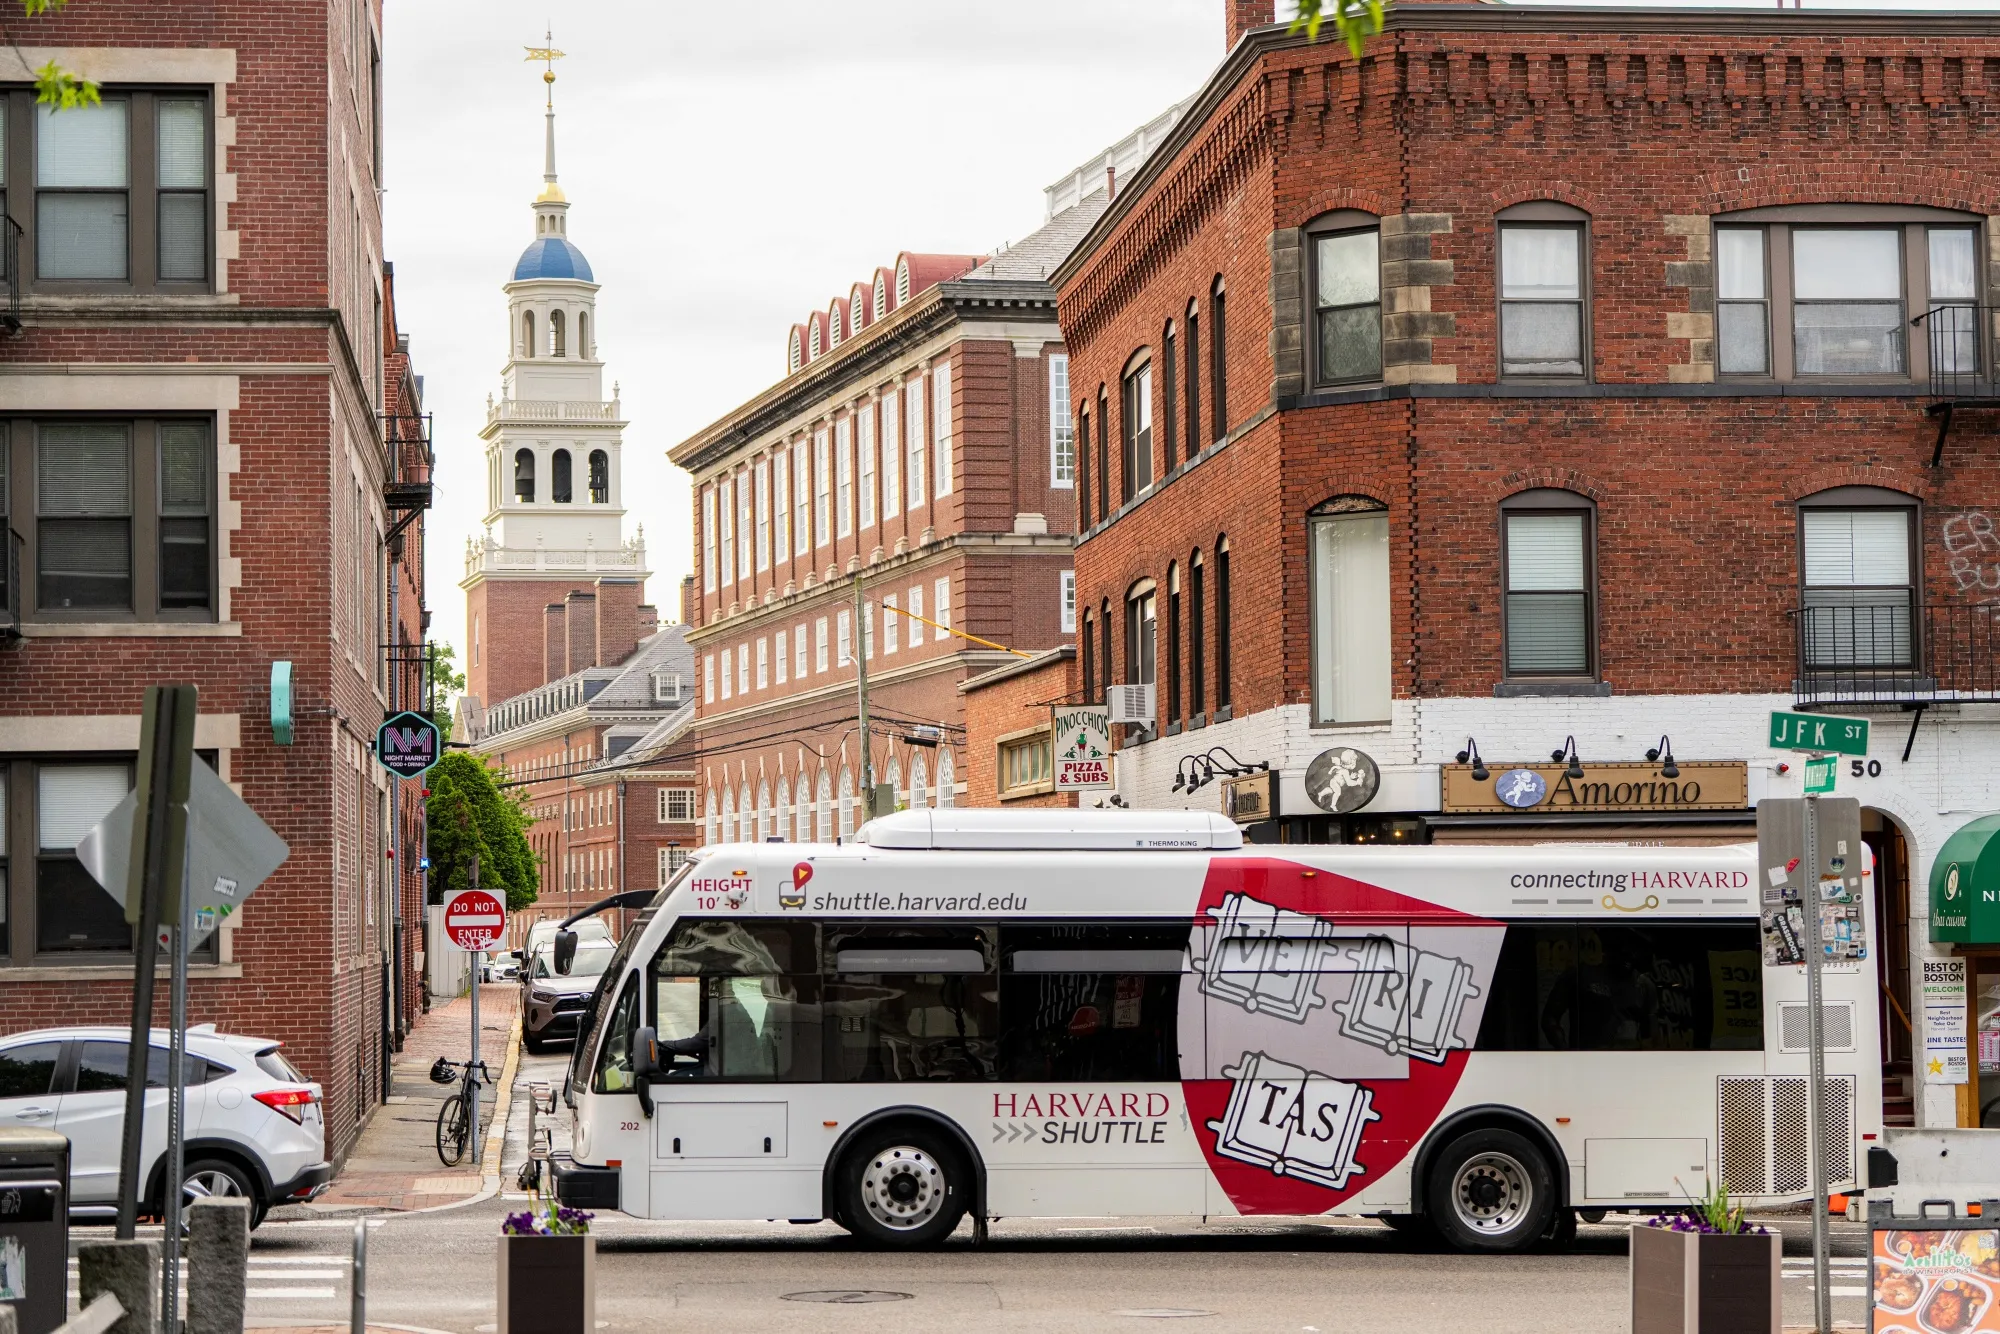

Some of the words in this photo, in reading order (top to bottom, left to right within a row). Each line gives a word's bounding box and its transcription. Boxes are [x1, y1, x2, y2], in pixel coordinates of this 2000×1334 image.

[1055, 711, 1109, 743] PINOCCHIO'S
[1776, 719, 1826, 746] JFK
[1844, 725, 1862, 739] ST
[384, 727, 432, 753] NM
[1064, 762, 1103, 772] PIZZA
[1851, 760, 1881, 778] 50
[1059, 773, 1069, 783] &
[1073, 772, 1109, 783] SUBS
[1548, 770, 1701, 806] Amorino
[691, 879, 753, 892] HEIGHT
[1631, 871, 1748, 889] HARVARD
[453, 902, 468, 912] DO
[474, 902, 496, 912] NOT
[813, 892, 1027, 911] shuttle.harvard.edu
[458, 928, 492, 939] ENTER
[1777, 915, 1800, 959] GRASSROOTS
[1924, 963, 1948, 972] BEST
[1949, 963, 1964, 972] OF
[1924, 973, 1964, 982] BOSTON
[1924, 985, 1965, 993] WELCOME
[993, 1093, 1170, 1117] HARVARD
[620, 1121, 640, 1131] 202
[1041, 1121, 1167, 1144] SHUTTLE
